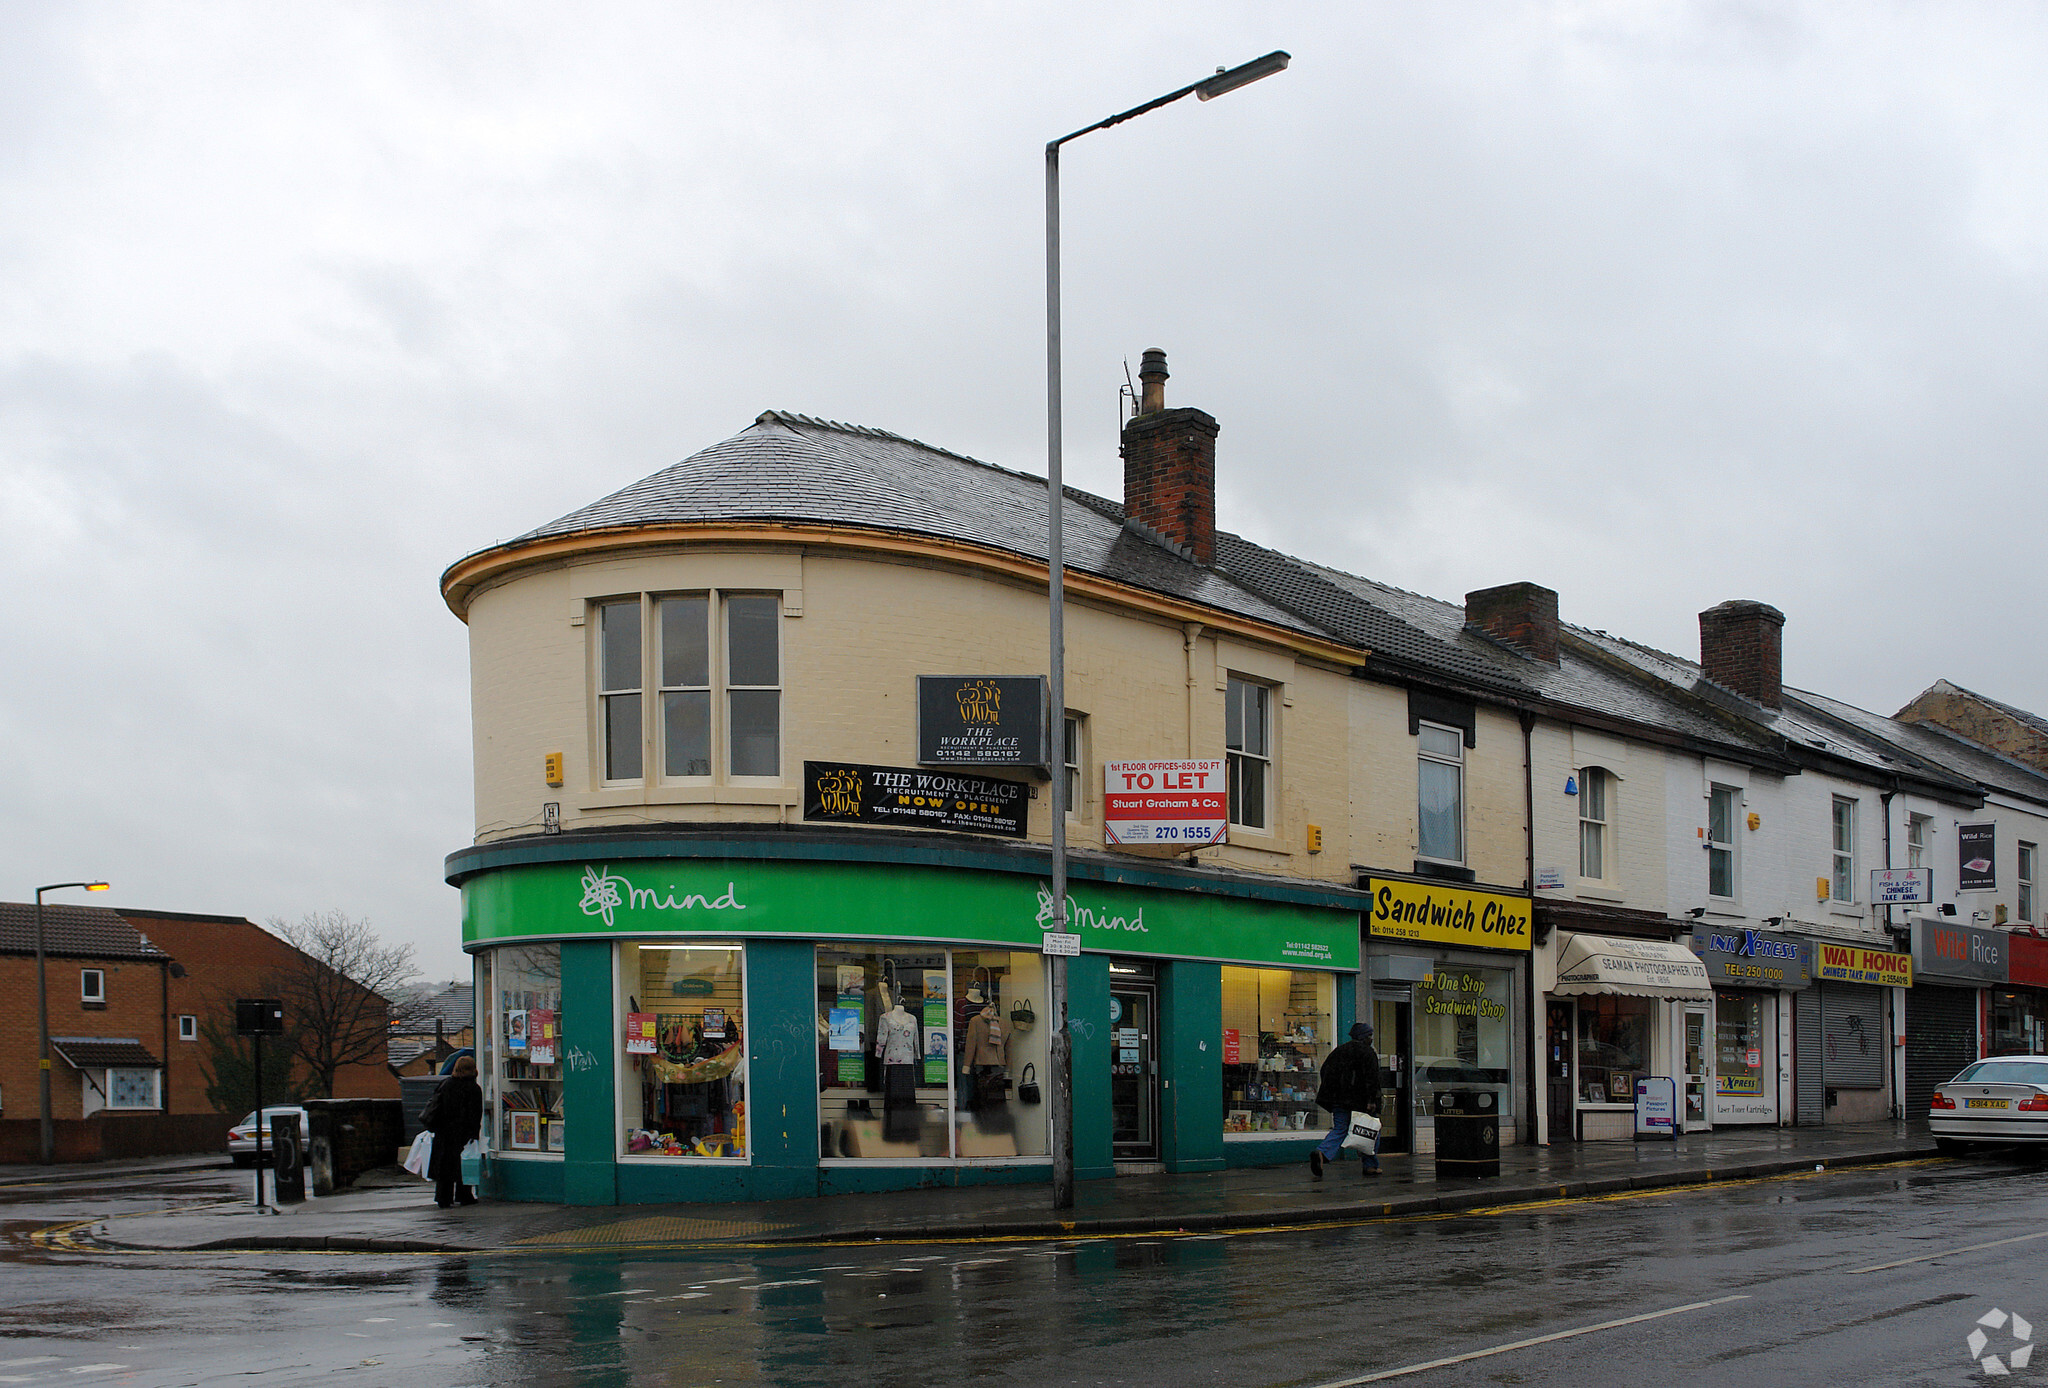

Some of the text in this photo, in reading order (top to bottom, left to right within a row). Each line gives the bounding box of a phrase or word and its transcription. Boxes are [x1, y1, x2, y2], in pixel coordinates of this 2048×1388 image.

[966, 727, 994, 737] THE
[940, 736, 1019, 746] WORKPLACE
[1110, 761, 1220, 772] 1st FLOOR OFFICES-850 SQ FT
[872, 771, 1018, 799] THE WORKPLACE
[1121, 772, 1209, 790] TO LET
[886, 787, 950, 798] RECRUITMENT
[964, 794, 1009, 805] PLACEMENT
[1112, 798, 1221, 809] Stuart Graham & Co.
[898, 795, 1000, 815] NOW OPEN
[548, 808, 555, 818] H
[872, 806, 891, 814] TEL:
[892, 807, 917, 816] 01142
[918, 809, 948, 818] 580167
[953, 812, 971, 821] FAX:
[972, 814, 992, 823] 01142
[940, 818, 1017, 832] www.theworkplaceuk.com
[1155, 826, 1211, 839] 270 1555
[629, 880, 747, 910] mind
[1886, 886, 1913, 894] CHINESE
[1901, 893, 1919, 901] AWAY
[1375, 885, 1527, 936] Sandwich Chez
[1073, 906, 1149, 933] mind
[1371, 925, 1420, 938] Tel: 0114 258 1213
[1709, 932, 1738, 953] INK
[1739, 929, 1799, 960] XPRESS
[1933, 928, 1999, 964] Wild Rice
[1282, 949, 1332, 960] www.mind.org.uk
[1823, 946, 1855, 968] WAI
[1862, 951, 1908, 974] HONG
[1602, 958, 1705, 977] SEAMAN PHOTOGRAPHER LTD
[1724, 963, 1783, 980] TEL: 250 1000
[1822, 965, 1847, 979] CHINESE
[1848, 969, 1863, 981] TAKE
[1864, 970, 1881, 982] AWAY
[1437, 972, 1459, 991] One
[1461, 973, 1485, 997] Stop
[1560, 973, 1600, 982] PHOTOGRAPHER
[1425, 995, 1506, 1022] Sandwich Shop
[1725, 1077, 1756, 1090] XPRESS
[1717, 1104, 1773, 1115] Laser Toner Cartridges
[1989, 1100, 2006, 1108] XAG
[1354, 1127, 1377, 1138] NEXT
